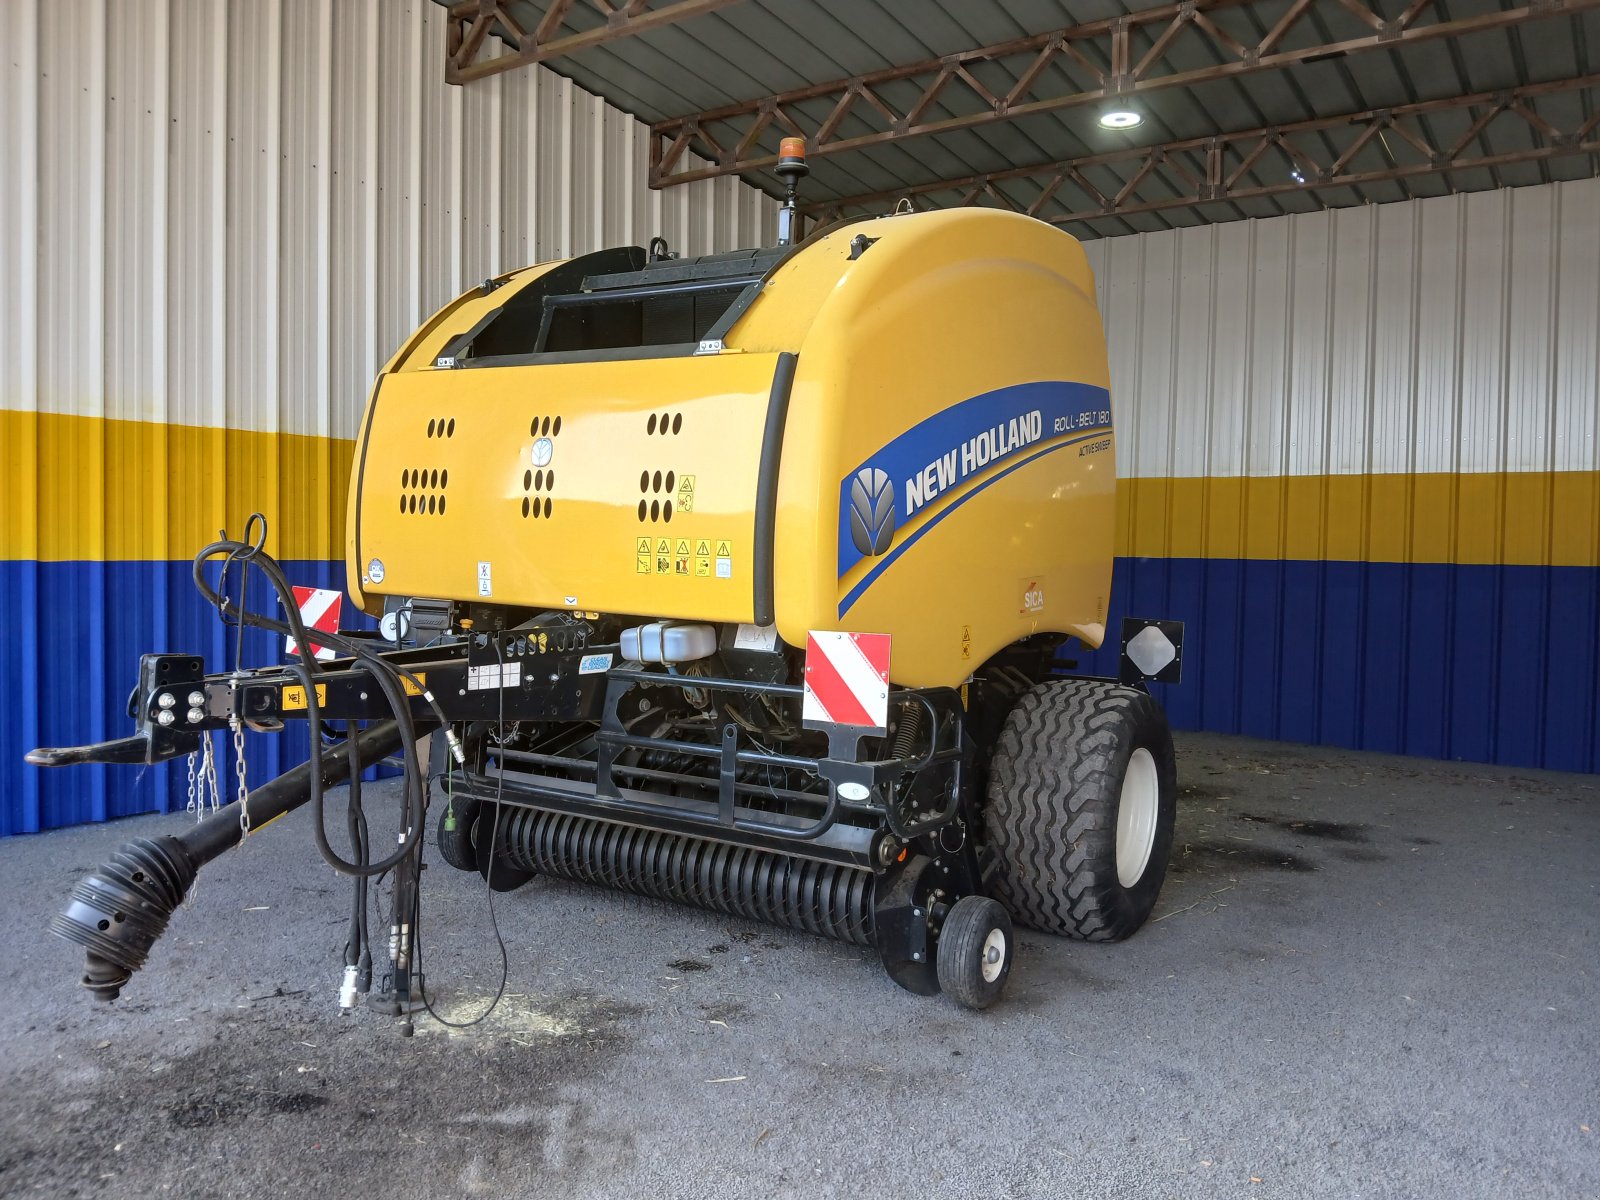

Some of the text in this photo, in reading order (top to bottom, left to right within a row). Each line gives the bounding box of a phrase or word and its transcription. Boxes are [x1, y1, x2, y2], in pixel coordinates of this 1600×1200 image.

[1098, 410, 1110, 424] 180
[905, 409, 1042, 517] NEW HOLLAND
[1024, 590, 1044, 608] SICA
